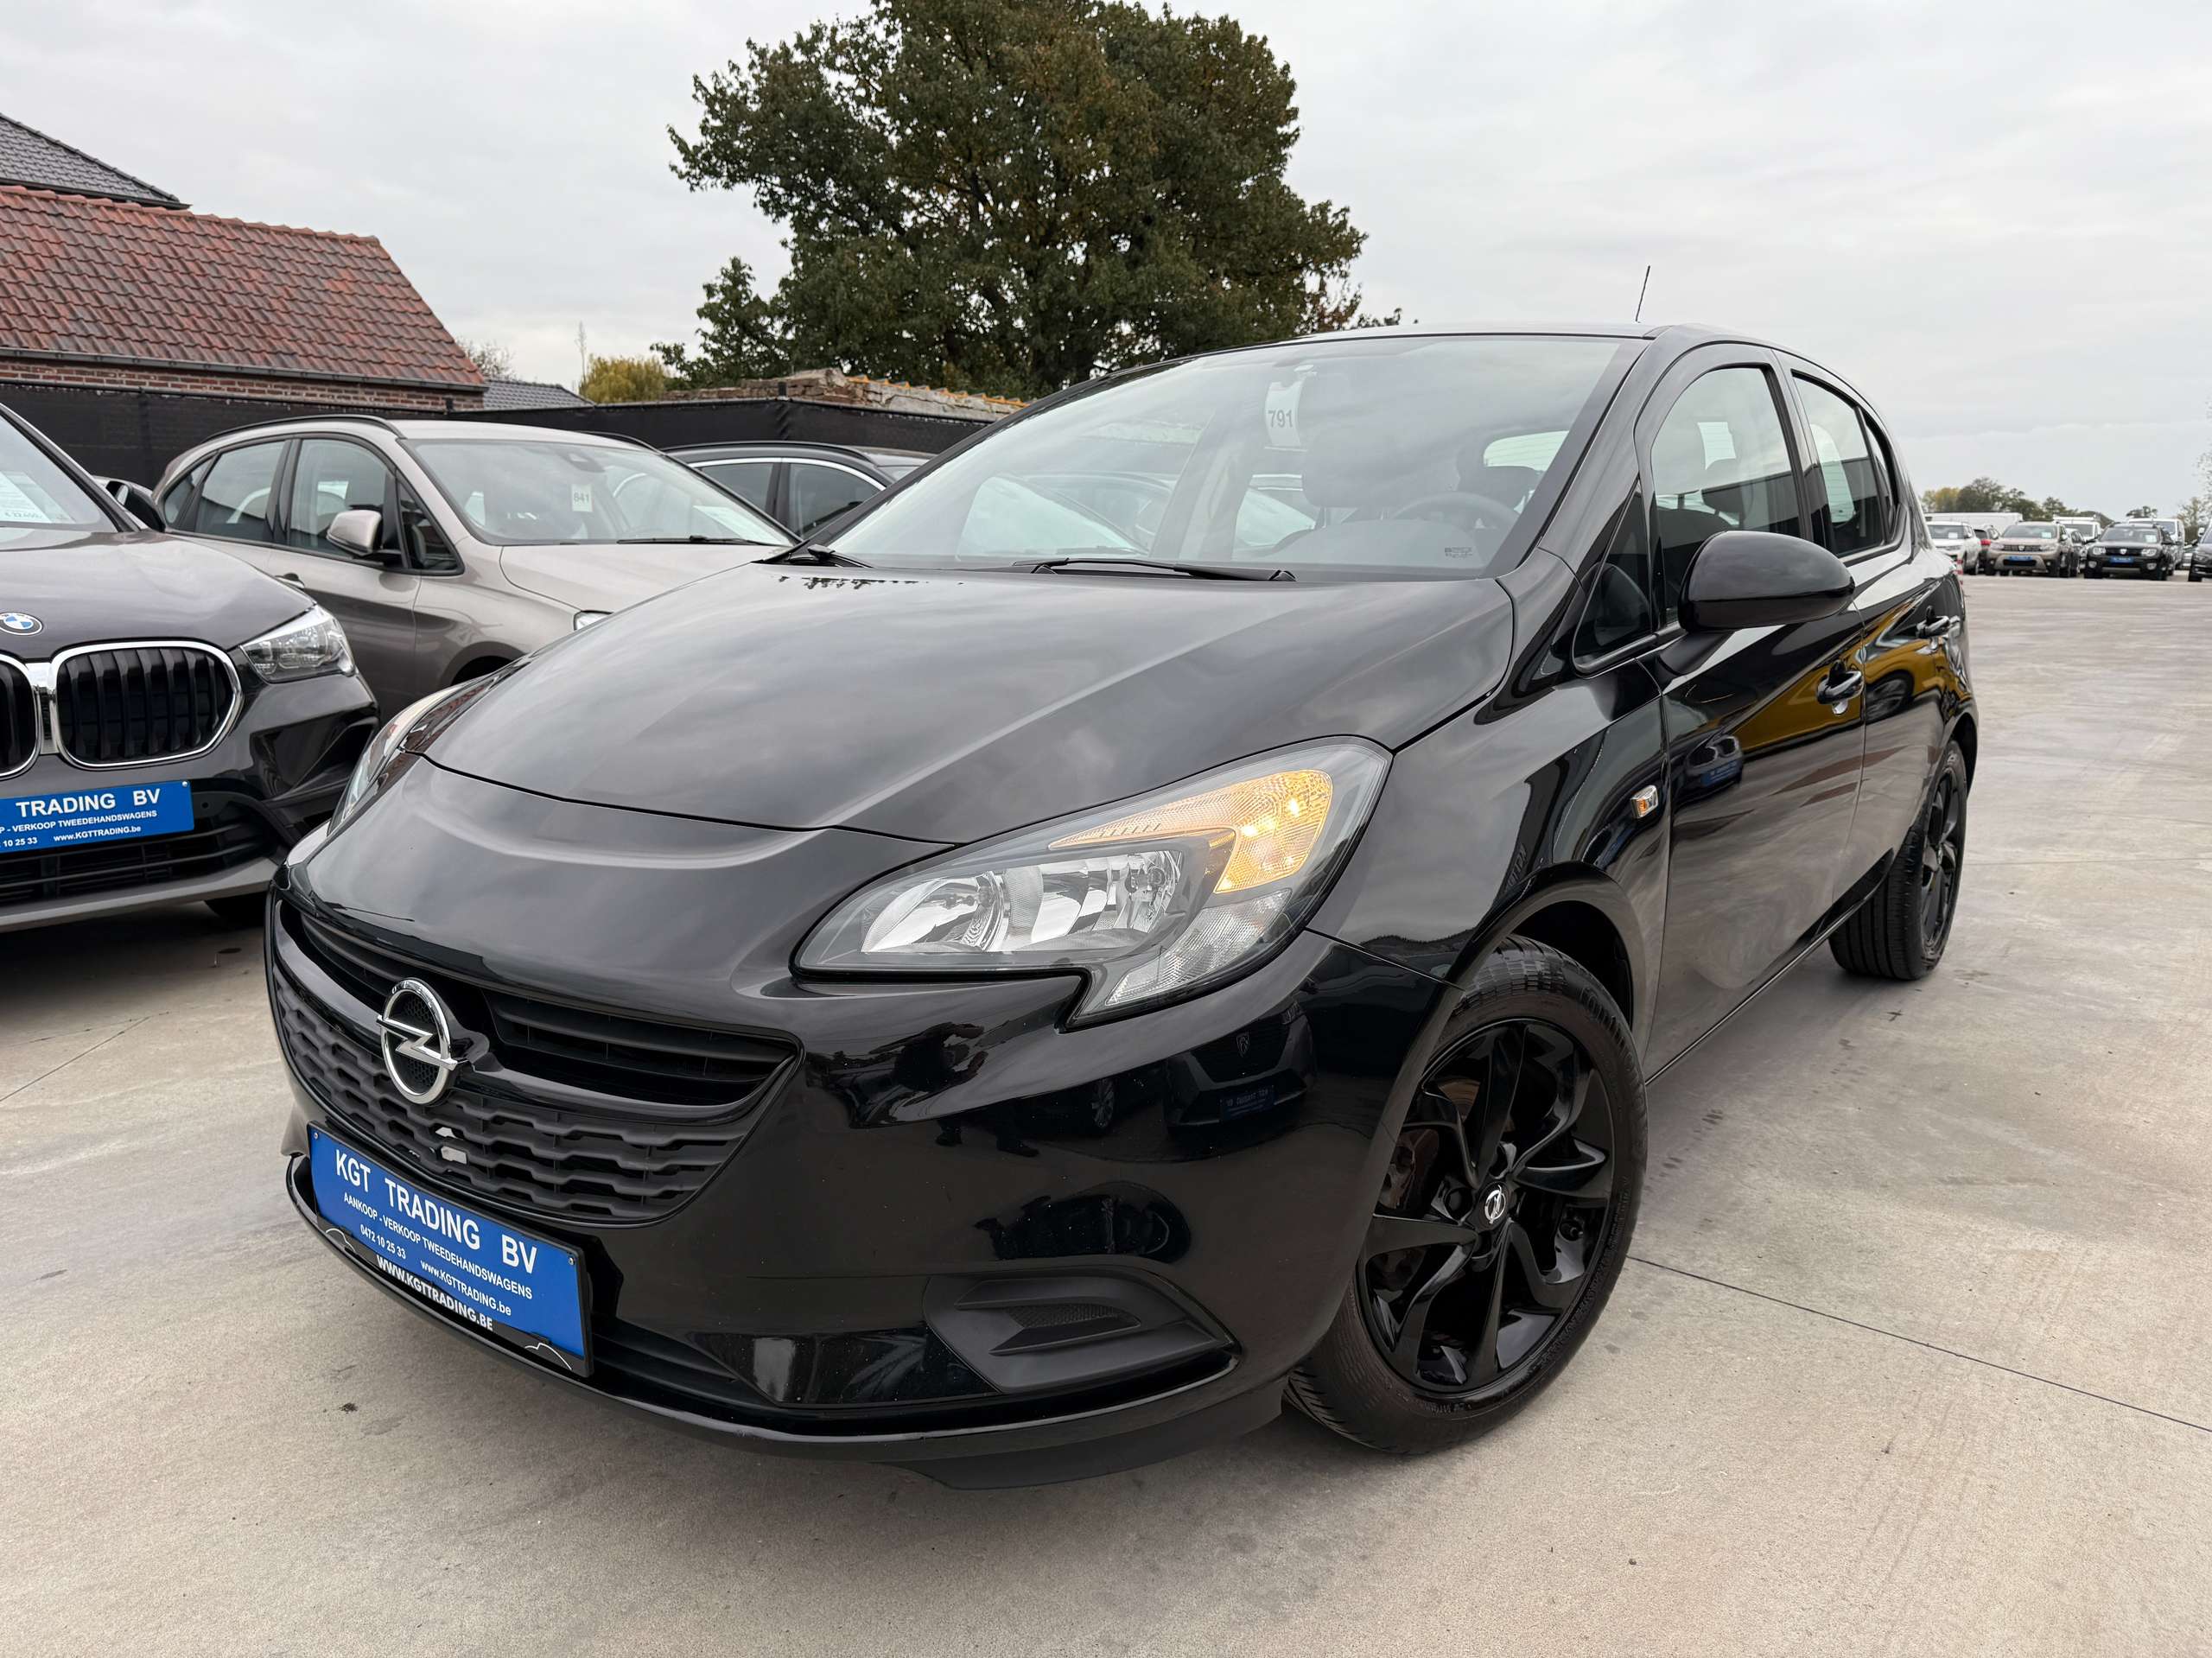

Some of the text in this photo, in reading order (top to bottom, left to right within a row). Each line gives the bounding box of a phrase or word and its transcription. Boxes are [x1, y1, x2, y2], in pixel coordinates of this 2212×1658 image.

[1268, 410, 1293, 428] 791
[12, 821, 56, 832] VERKOOP
[58, 810, 157, 827] TWEEDEHANDSWAGENS
[16, 788, 161, 817] TRADING BV
[53, 826, 142, 842] www.KGTTRADING.be
[336, 1149, 537, 1274] KGT TRADING BV
[344, 1192, 378, 1220] AANKOOP
[382, 1215, 421, 1244] VERKOOP
[422, 1236, 533, 1299] TWEEDEHANDSWAGENS
[360, 1224, 512, 1316] 0472 10 25 33 www.KGTTRADING.be
[376, 1255, 493, 1331] WWW.KGTTRADING.BE
